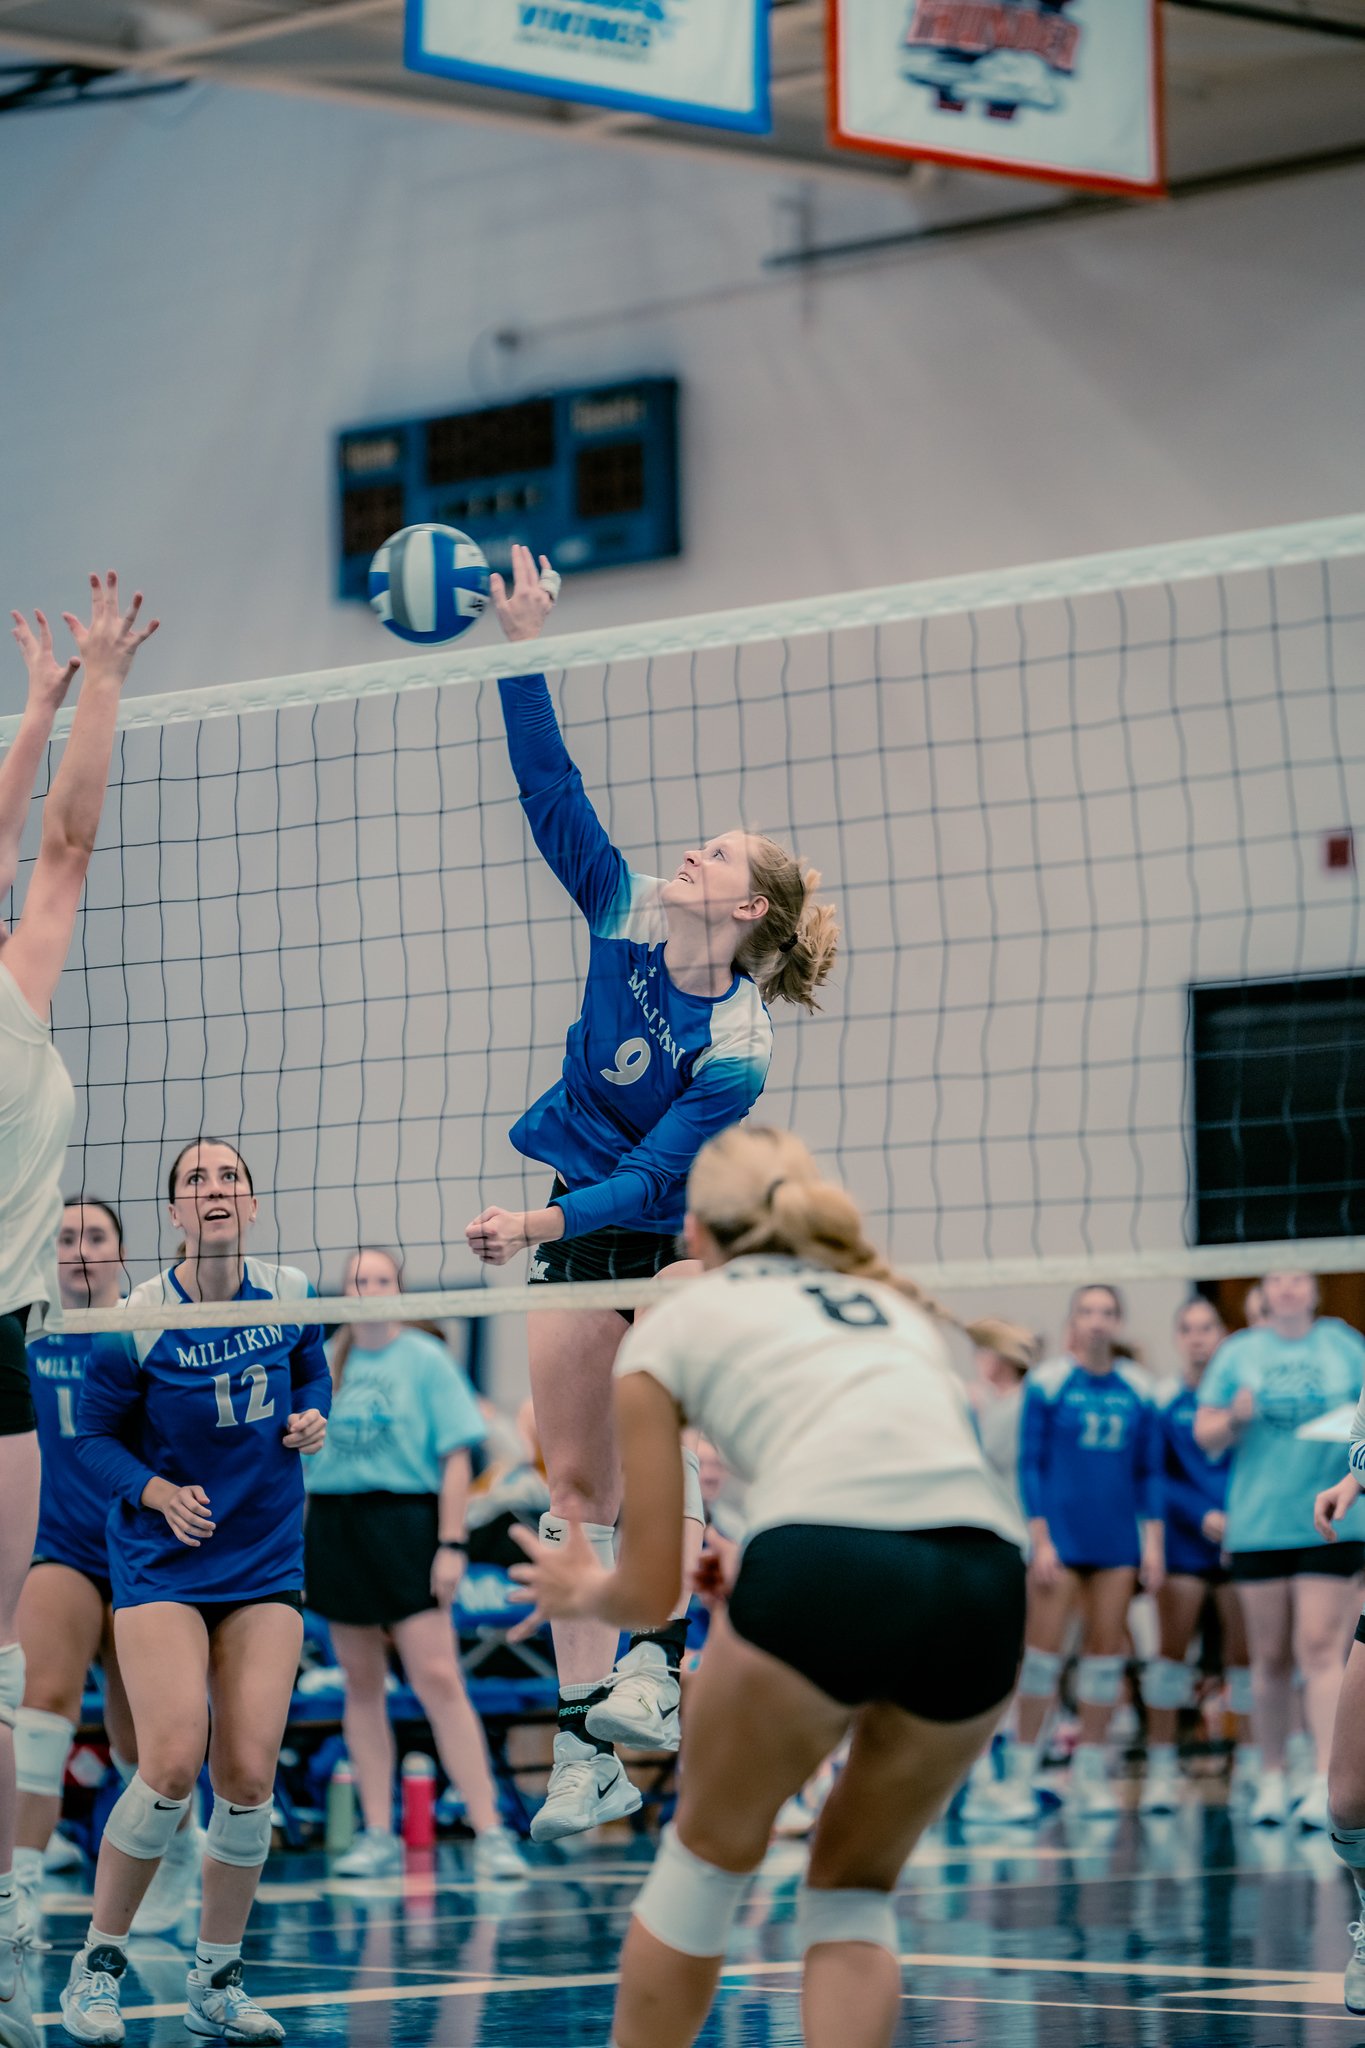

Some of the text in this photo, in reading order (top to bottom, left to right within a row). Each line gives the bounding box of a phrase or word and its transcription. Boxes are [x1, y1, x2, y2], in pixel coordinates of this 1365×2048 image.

[599, 1036, 652, 1086] 9
[175, 1323, 283, 1368] MILLIKIN
[210, 1363, 275, 1428] 12
